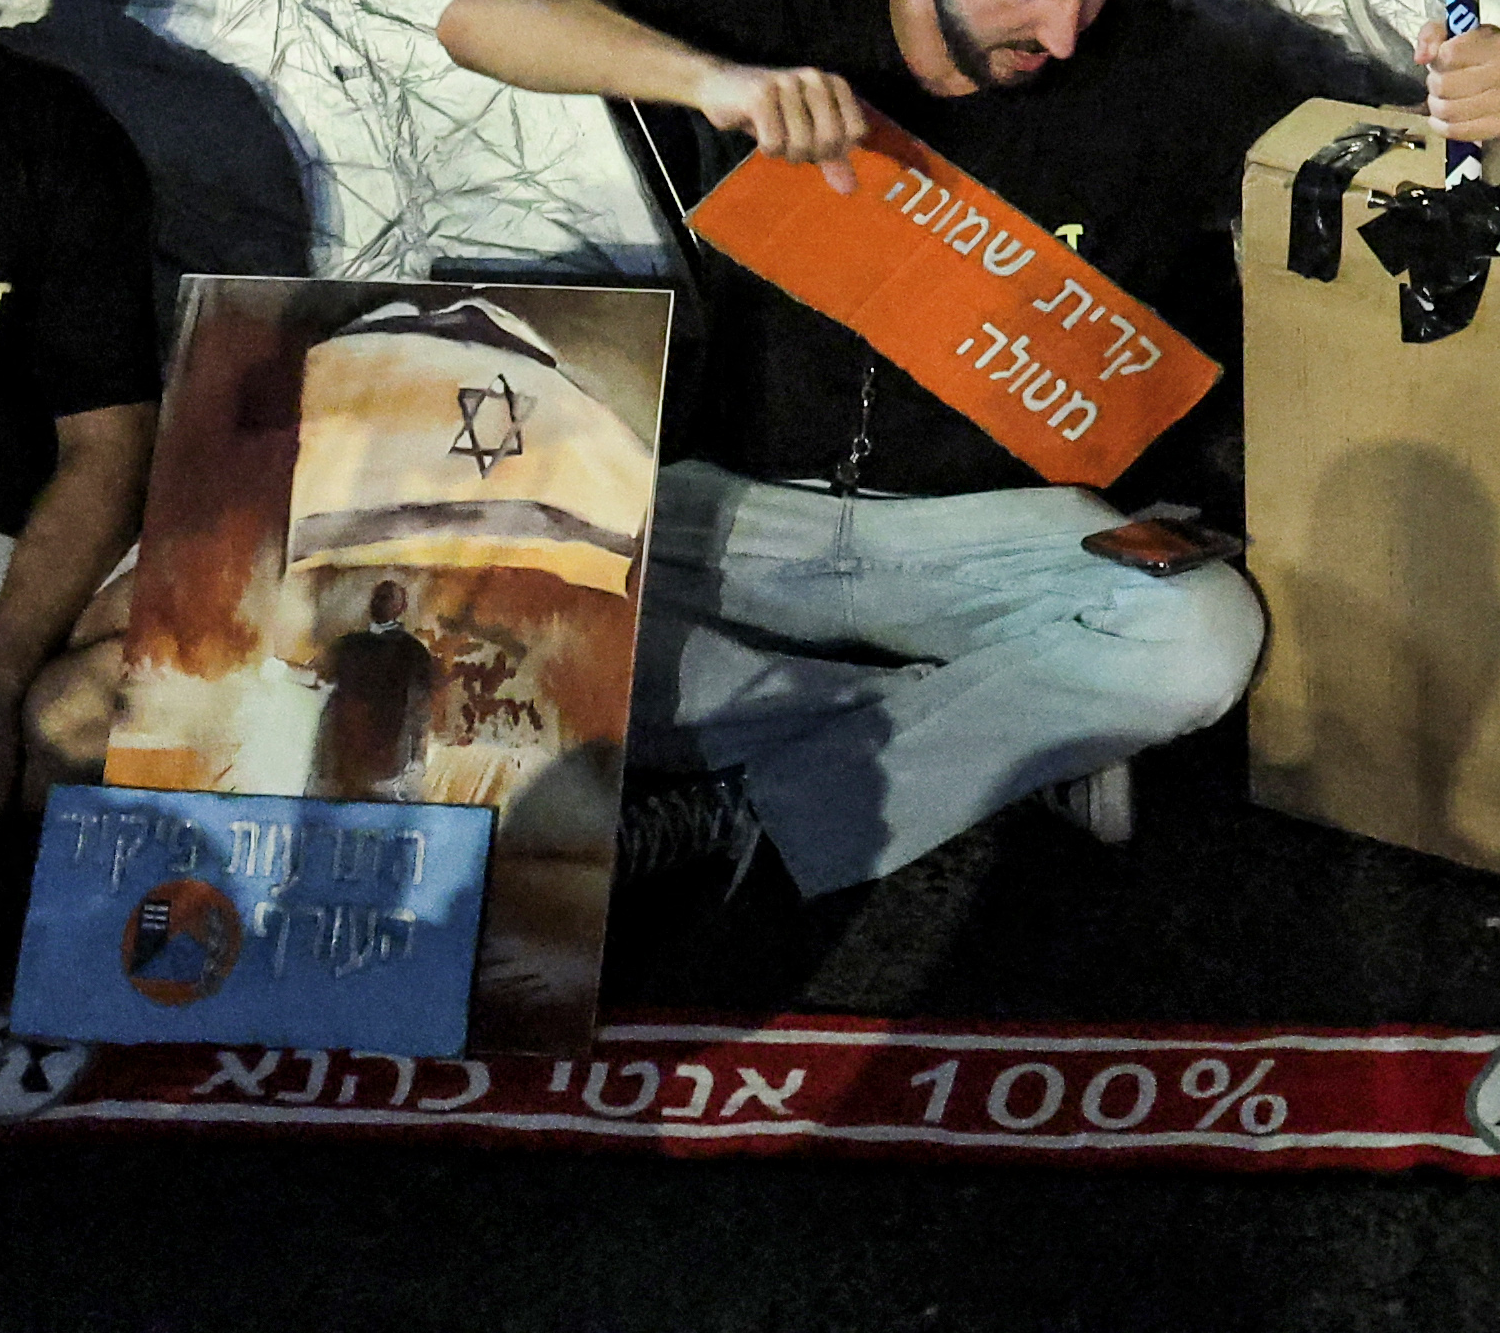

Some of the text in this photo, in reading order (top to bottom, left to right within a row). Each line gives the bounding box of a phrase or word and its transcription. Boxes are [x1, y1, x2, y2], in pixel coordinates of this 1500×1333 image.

[884, 167, 1163, 381] קרית שמונה
[955, 322, 1098, 442] מטולה
[196, 1048, 1291, 1135] 100% אנטי כהנא
